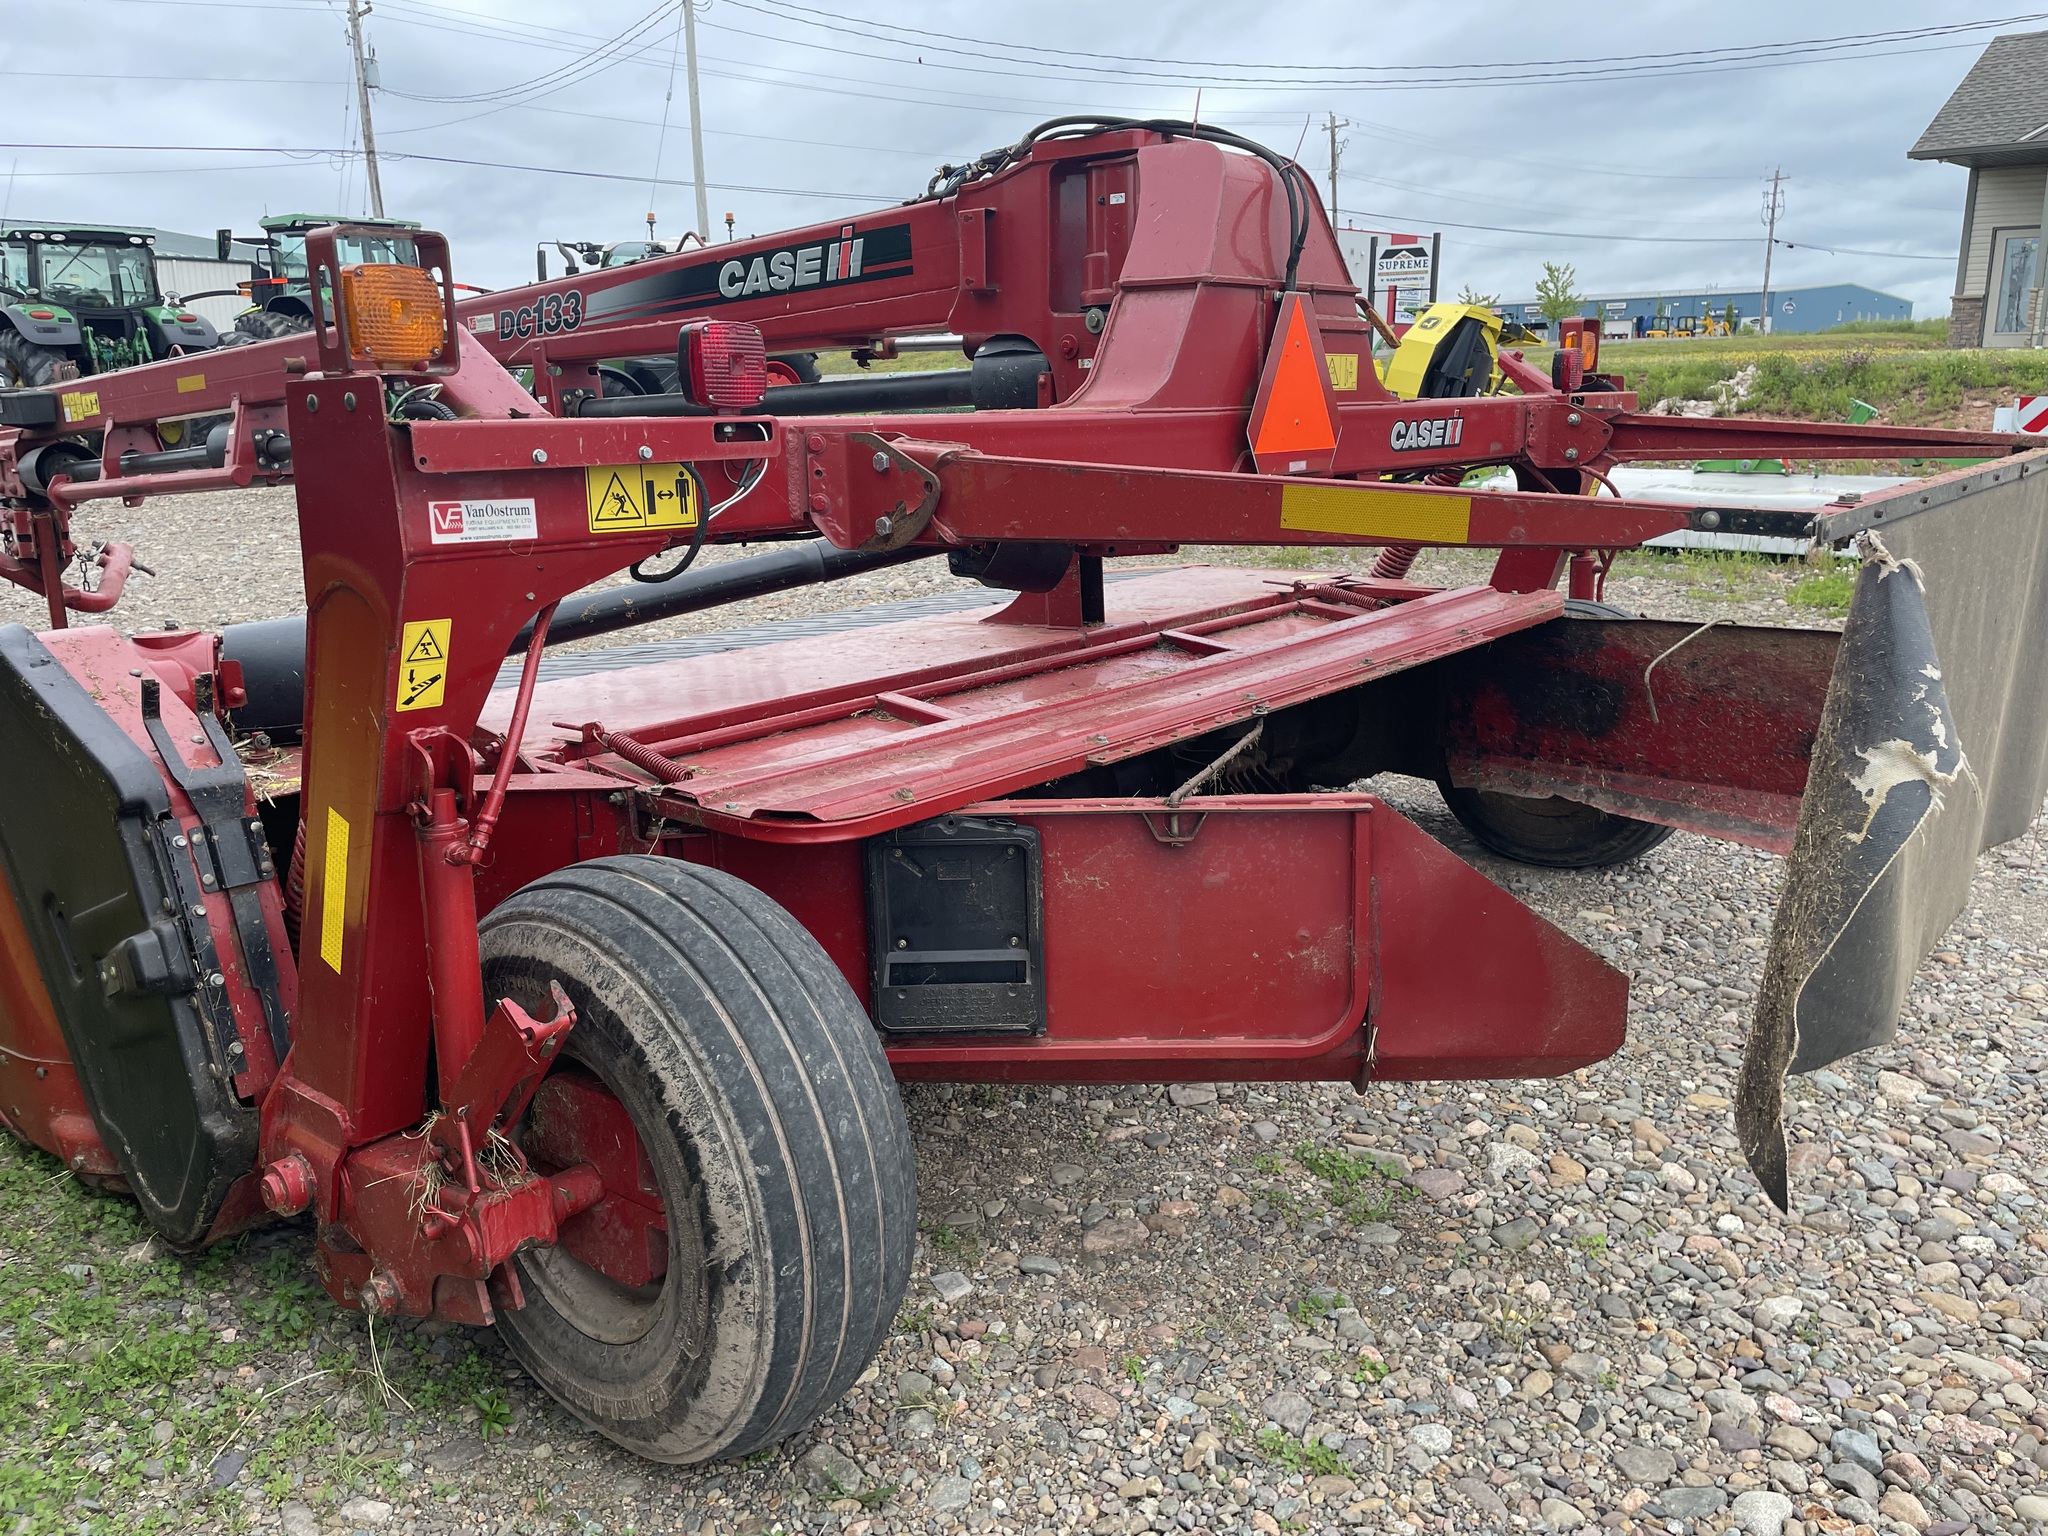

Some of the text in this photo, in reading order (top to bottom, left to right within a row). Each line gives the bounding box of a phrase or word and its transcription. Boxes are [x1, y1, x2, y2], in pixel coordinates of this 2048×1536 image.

[718, 247, 822, 298] CASE
[1378, 259, 1428, 270] SUPREME
[499, 289, 582, 341] DC133
[1390, 420, 1445, 450] CASE
[465, 503, 530, 518] VanOostrum
[485, 518, 520, 526] EQUIPMENT
